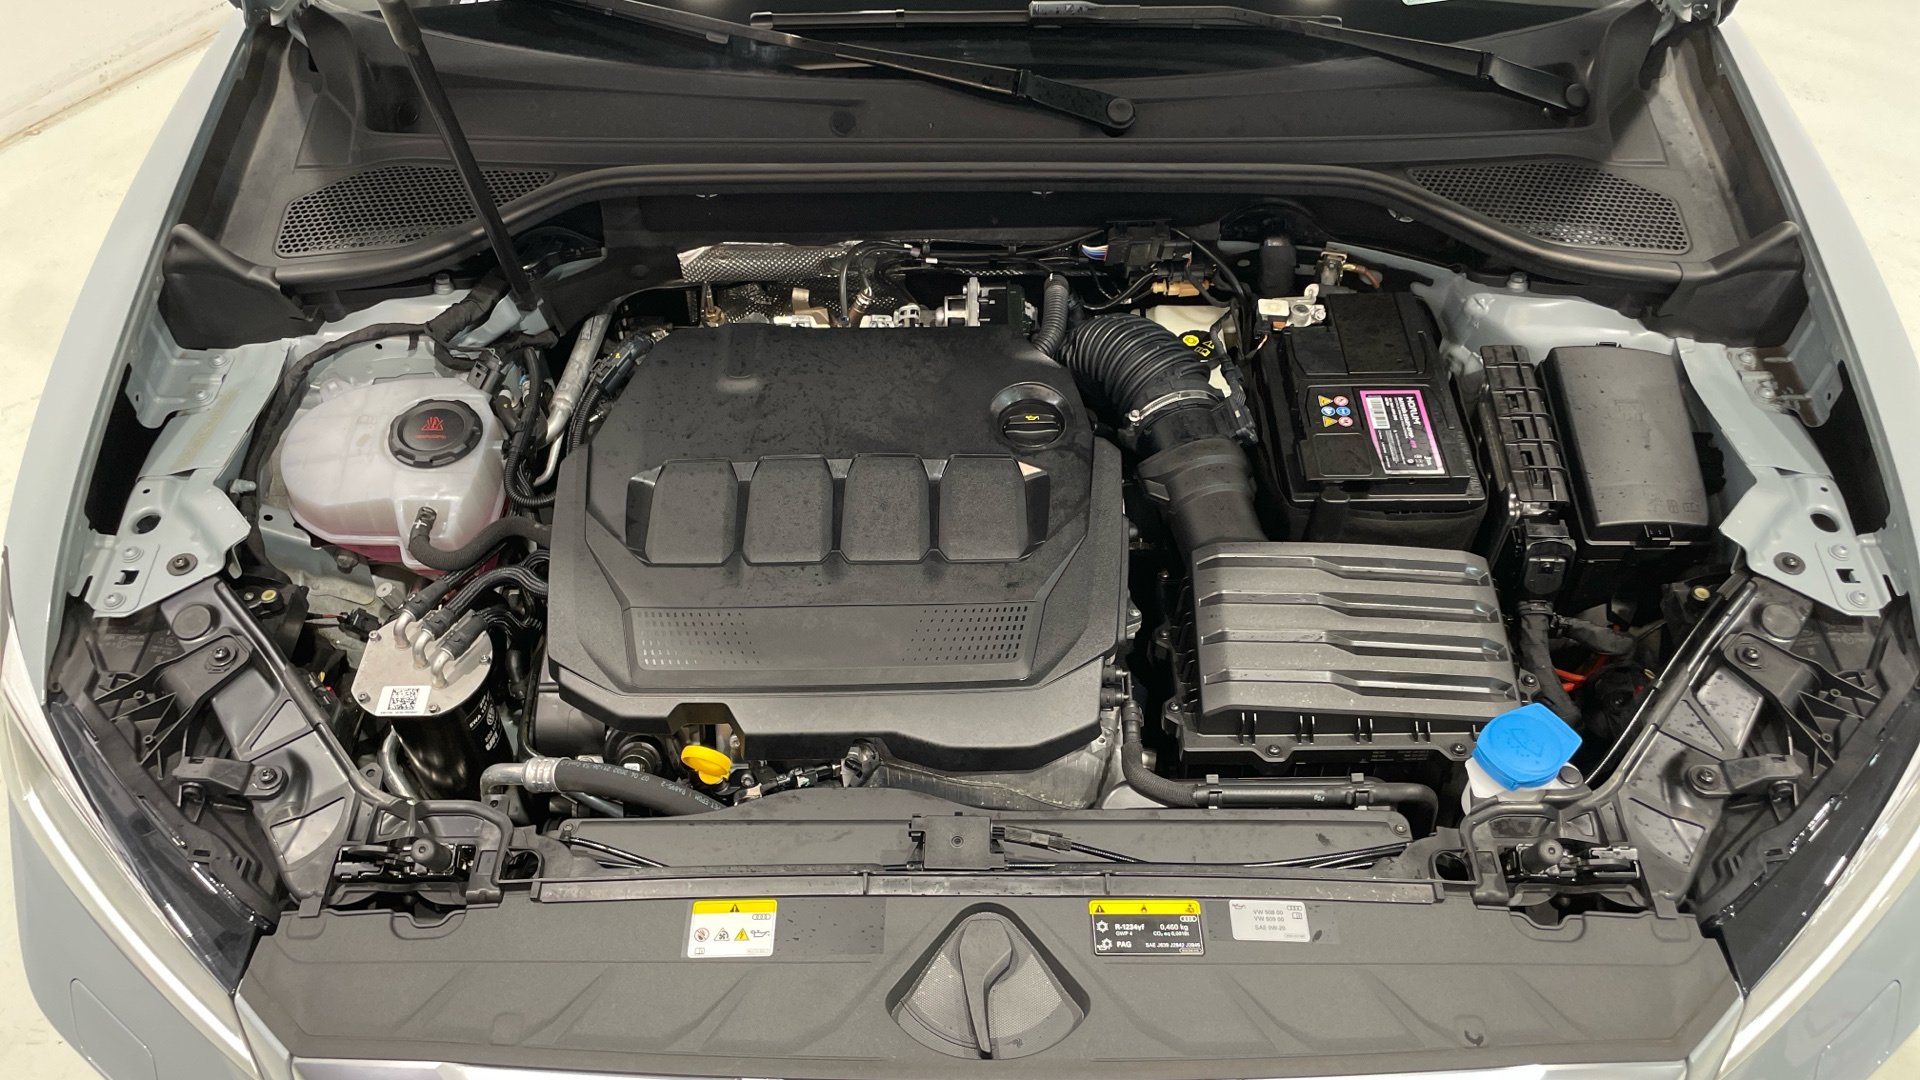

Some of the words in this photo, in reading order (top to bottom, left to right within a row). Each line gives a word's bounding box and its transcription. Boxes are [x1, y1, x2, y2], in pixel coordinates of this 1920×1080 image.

[1114, 923, 1145, 931] R-1234yf
[1179, 923, 1189, 931] kg
[1116, 940, 1132, 948] PAG
